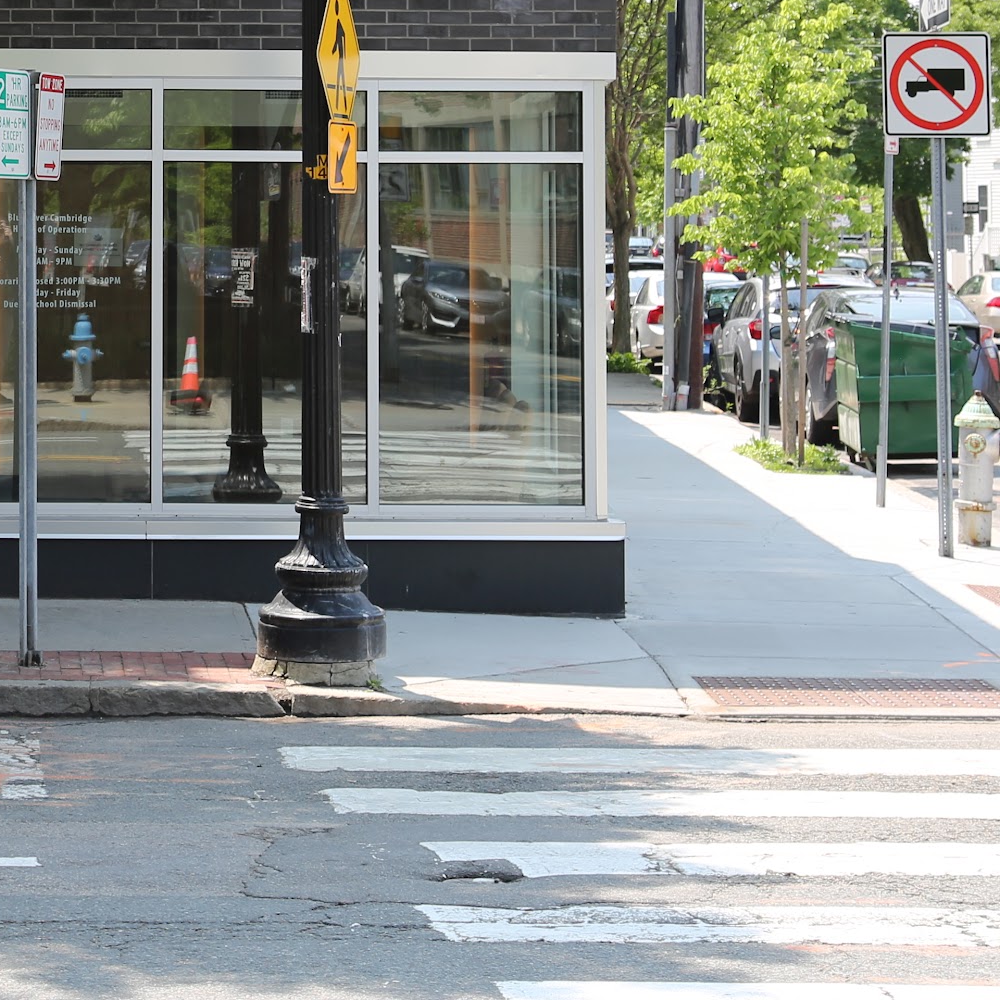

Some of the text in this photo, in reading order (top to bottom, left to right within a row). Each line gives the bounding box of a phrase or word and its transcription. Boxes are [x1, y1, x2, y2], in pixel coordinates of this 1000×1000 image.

[12, 77, 22, 90] HR
[42, 77, 63, 91] TOW ZONE
[7, 94, 28, 107] PARKING
[47, 98, 55, 110] NO
[40, 118, 60, 131] STOPPING
[3, 130, 22, 141] EXCEPT
[1, 142, 25, 154] SUNDAYS
[39, 138, 59, 152] ANYTIME
[50, 213, 93, 224] Cambridge
[37, 225, 87, 235] of Operation
[54, 246, 83, 256] Sunday
[55, 257, 72, 265] 9PM
[55, 277, 85, 285] 3:00PM
[92, 277, 121, 285] 3:30PM
[56, 288, 81, 298] Friday
[3, 299, 97, 308] Due chool Dismissal
